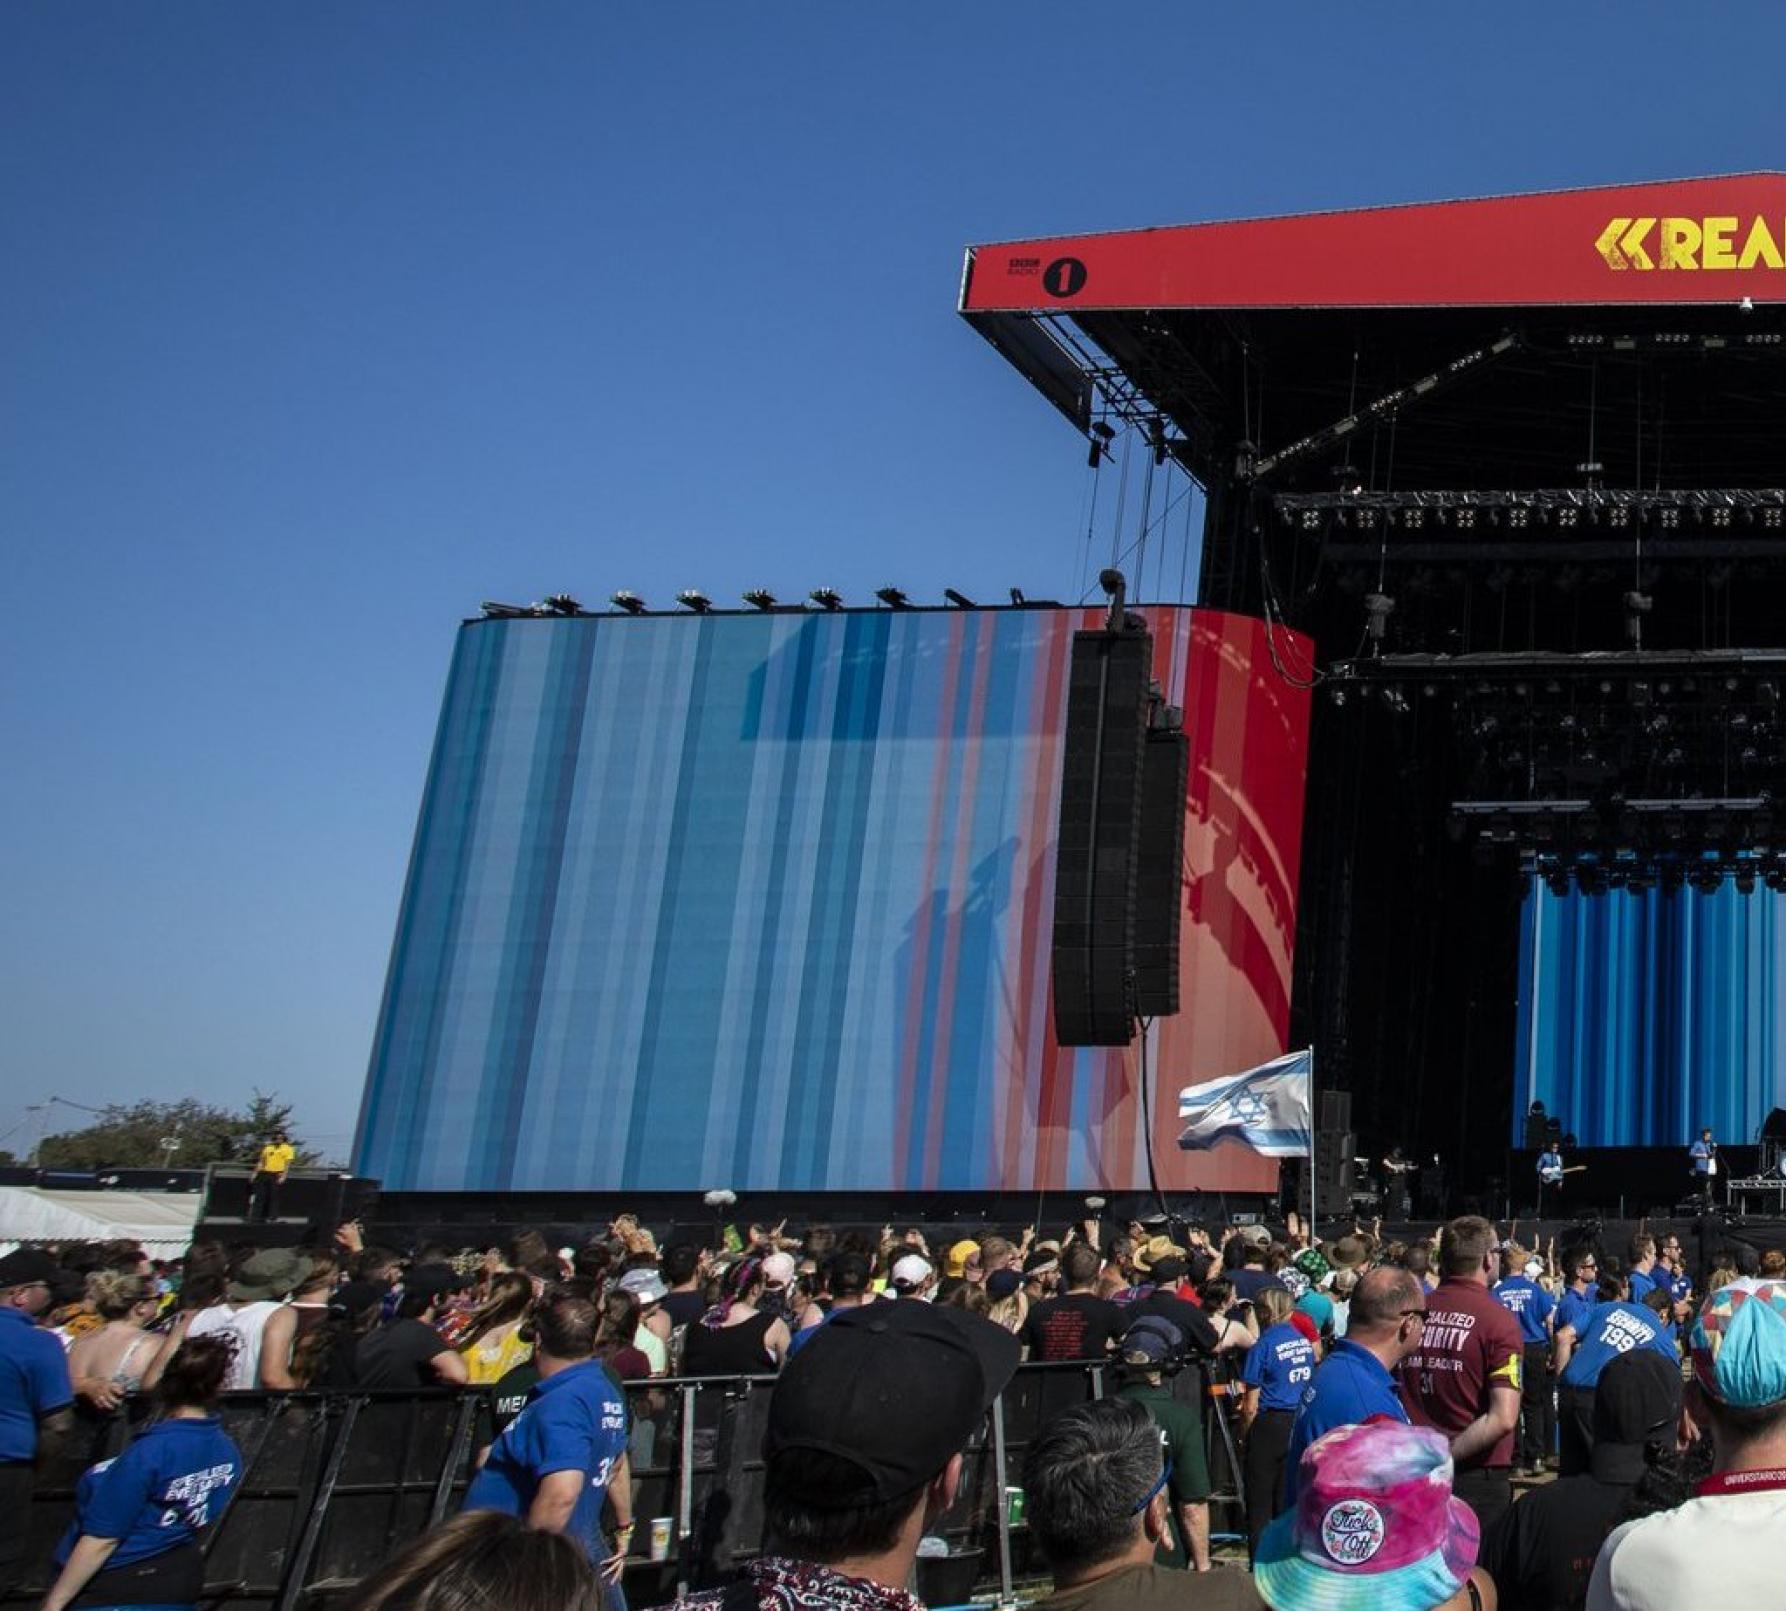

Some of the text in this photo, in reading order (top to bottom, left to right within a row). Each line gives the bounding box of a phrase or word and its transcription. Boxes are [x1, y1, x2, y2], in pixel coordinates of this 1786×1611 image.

[1425, 1311, 1476, 1329] IALIZED
[1600, 1324, 1636, 1353] 199
[1289, 1366, 1311, 1383] 679
[1343, 1535, 1371, 1560] Off
